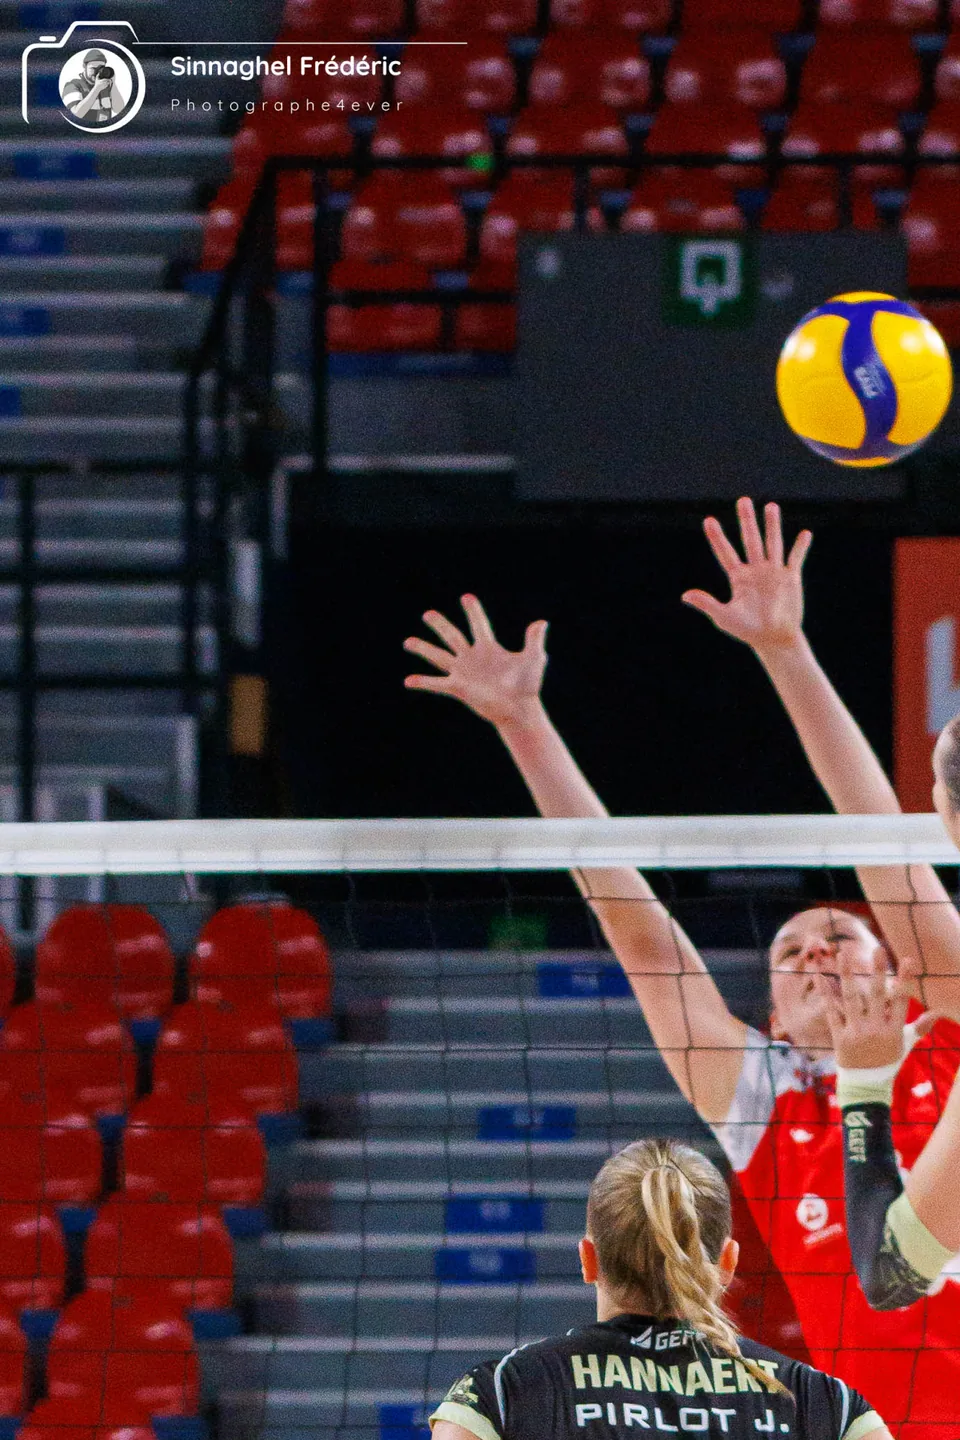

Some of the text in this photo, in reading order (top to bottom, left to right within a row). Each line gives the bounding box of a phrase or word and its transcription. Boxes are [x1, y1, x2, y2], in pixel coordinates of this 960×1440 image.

[571, 1353, 779, 1396] HANNAERT
[575, 1402, 790, 1433] PIRLOT J.
